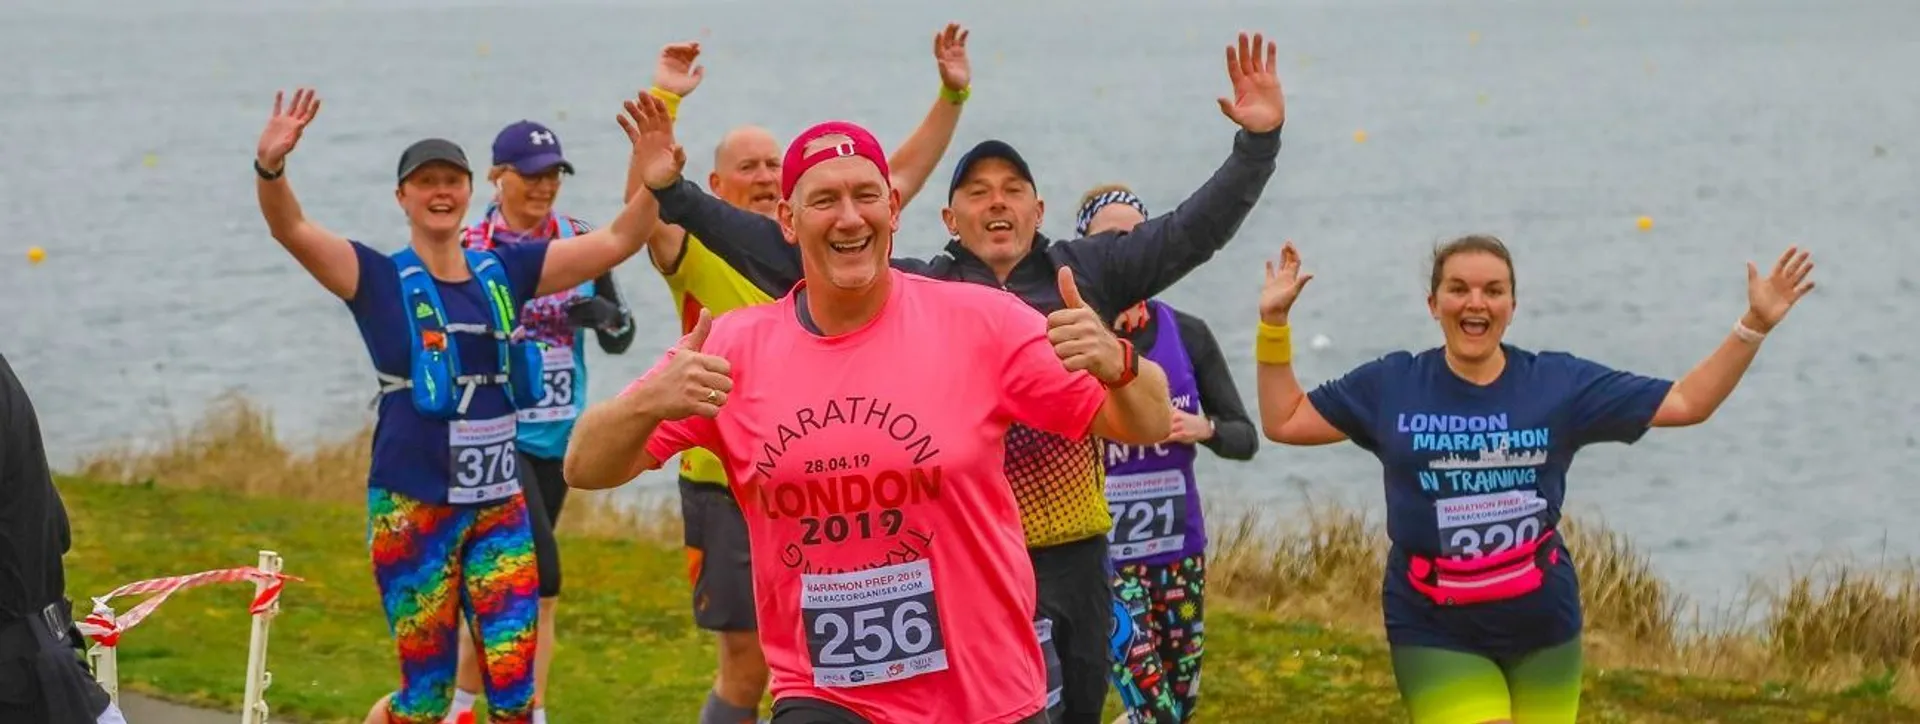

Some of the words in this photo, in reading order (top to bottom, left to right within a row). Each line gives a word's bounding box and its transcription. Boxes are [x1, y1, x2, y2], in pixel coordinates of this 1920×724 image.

[1397, 413, 1508, 433] LONDON
[756, 397, 940, 480] MARATHON
[1413, 428, 1549, 451] MARATHON
[457, 441, 515, 487] 376
[804, 453, 870, 474] 28.04.19
[758, 465, 942, 519] LONDON
[1418, 471, 1440, 491] IN
[1445, 468, 1536, 492] TRAINING
[1107, 499, 1175, 544] 721
[1444, 501, 1496, 514] MARATHON
[800, 508, 903, 545] 2019
[1450, 516, 1540, 562] 320
[807, 580, 862, 592] MARATHON
[865, 574, 894, 588] PREP
[898, 569, 922, 582] 2019
[807, 581, 923, 603] THERACEORGANISER.COM
[814, 600, 932, 665] 256
